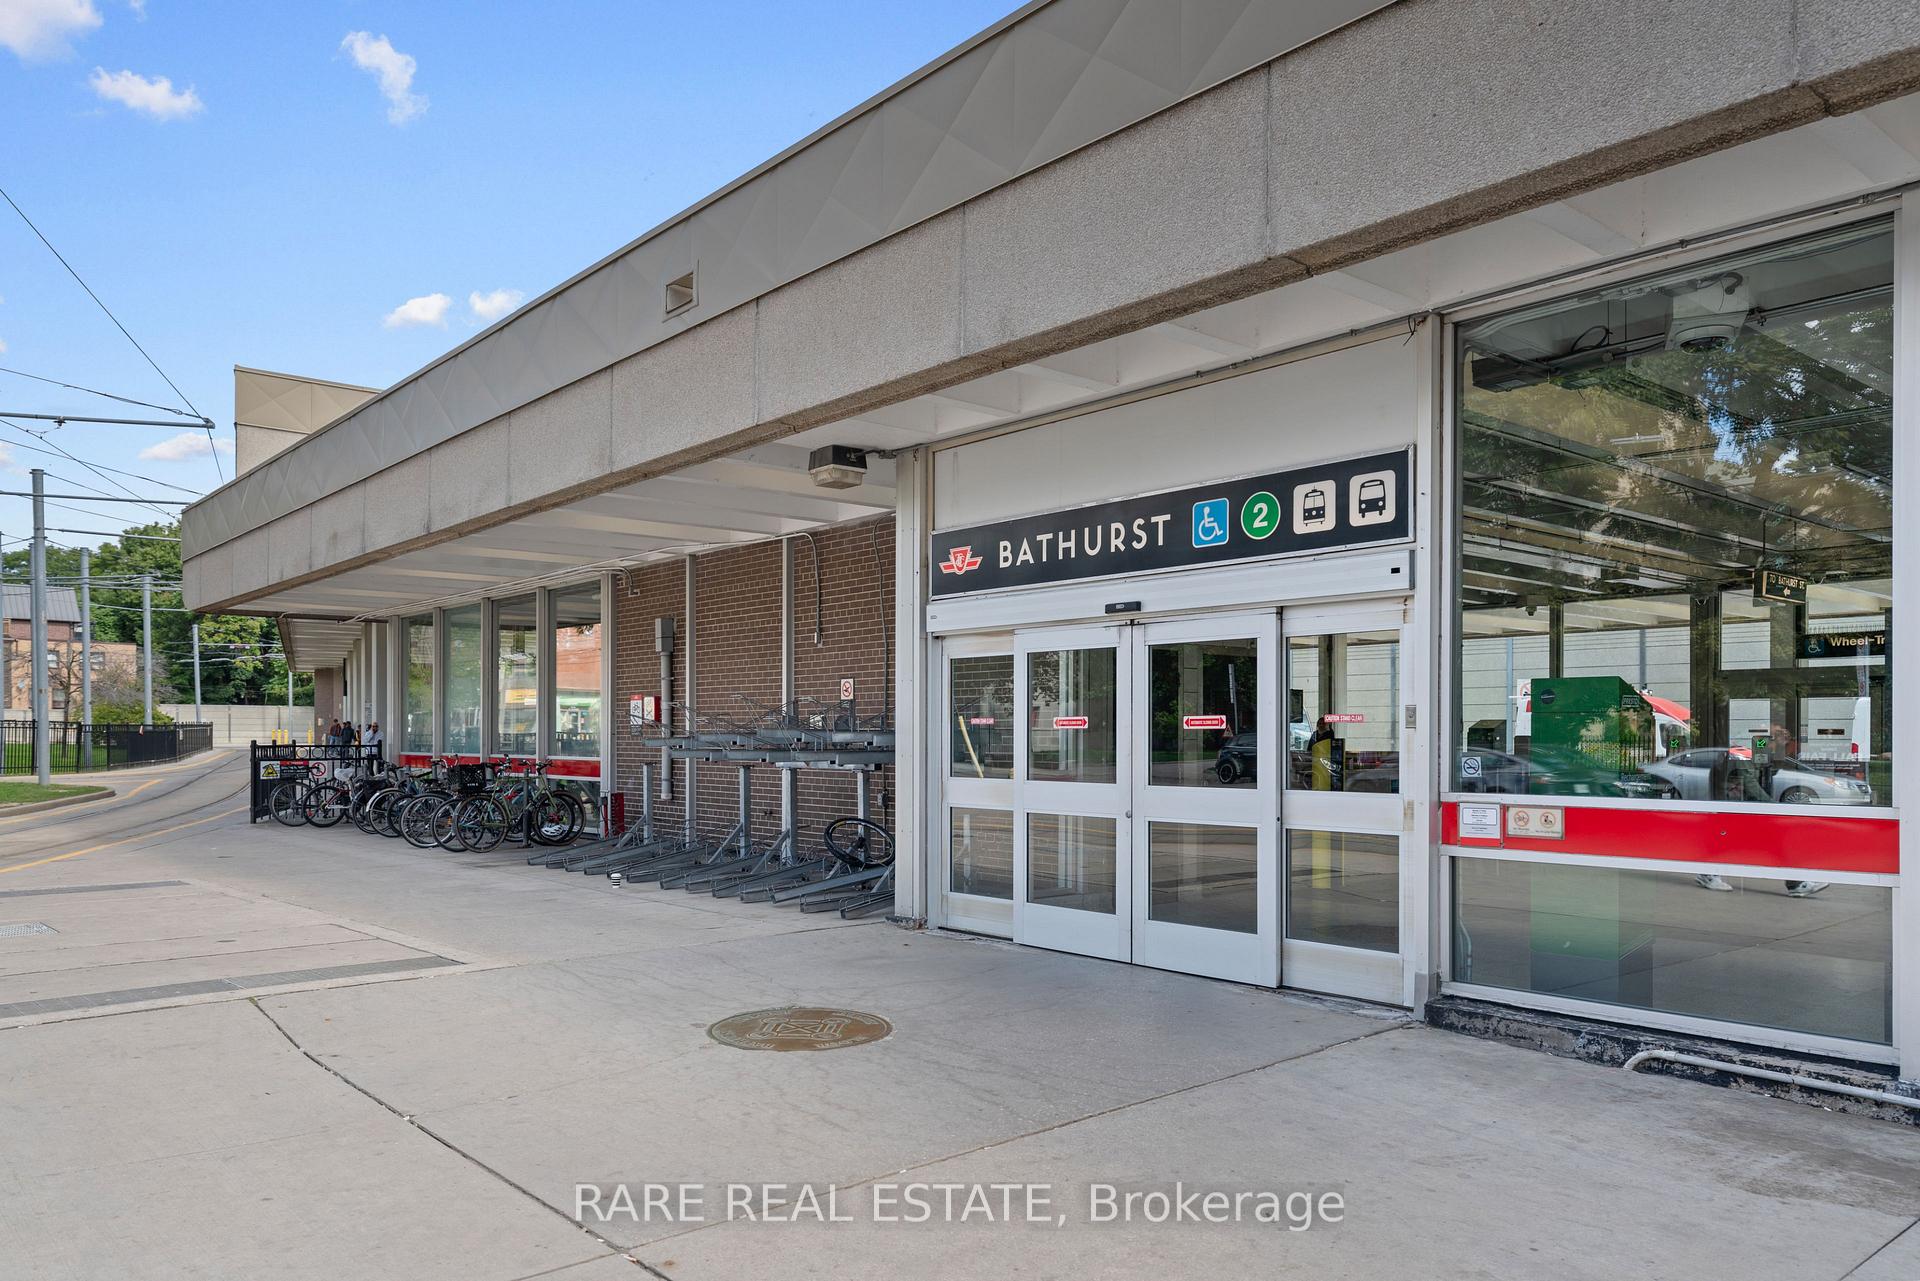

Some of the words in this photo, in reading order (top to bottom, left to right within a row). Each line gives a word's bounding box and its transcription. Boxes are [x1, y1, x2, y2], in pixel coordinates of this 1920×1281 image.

[999, 514, 1171, 569] BATHURST
[1252, 502, 1269, 529] 2
[1778, 575, 1798, 588] BATHURST
